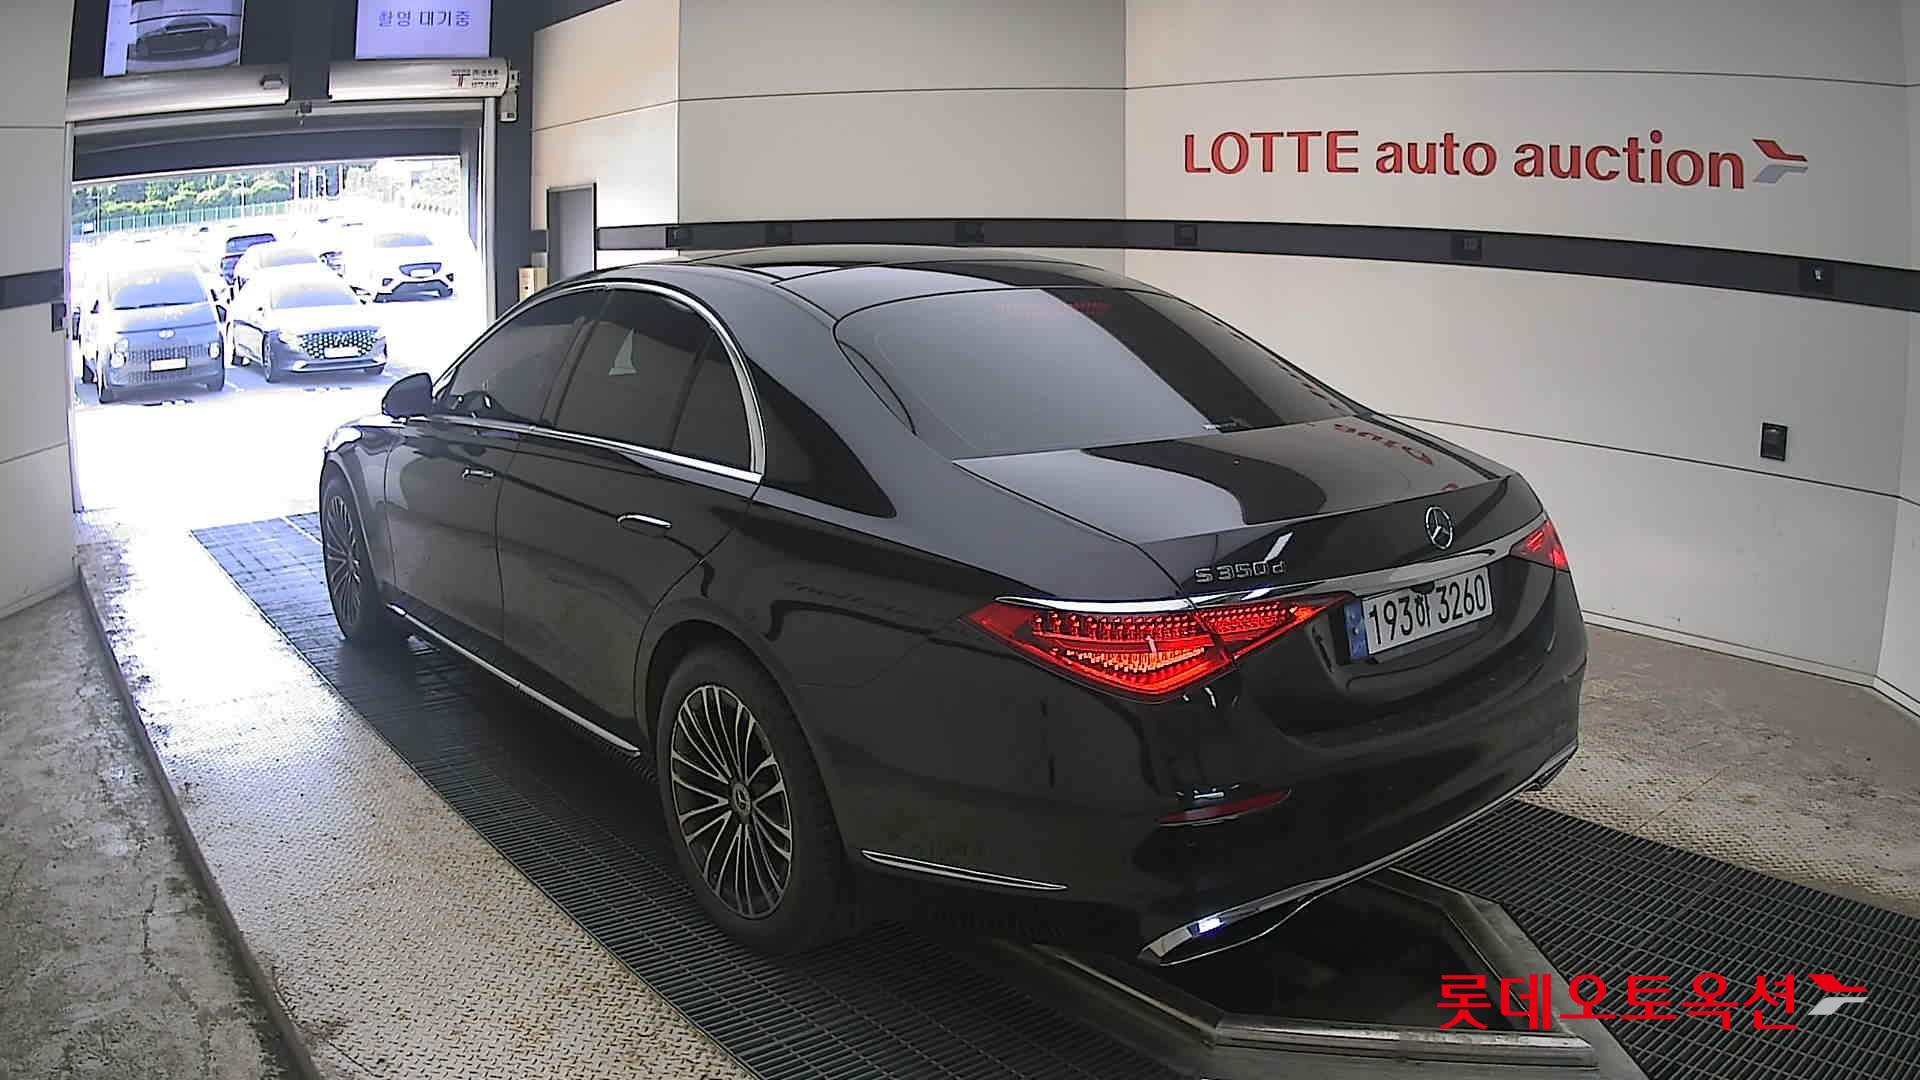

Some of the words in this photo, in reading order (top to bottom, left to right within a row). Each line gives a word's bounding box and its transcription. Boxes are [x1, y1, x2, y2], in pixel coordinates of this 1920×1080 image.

[1184, 131, 1359, 175] LOTTE
[1375, 132, 1498, 178] auto
[1513, 129, 1746, 189] auction
[1435, 574, 1488, 624] 3260
